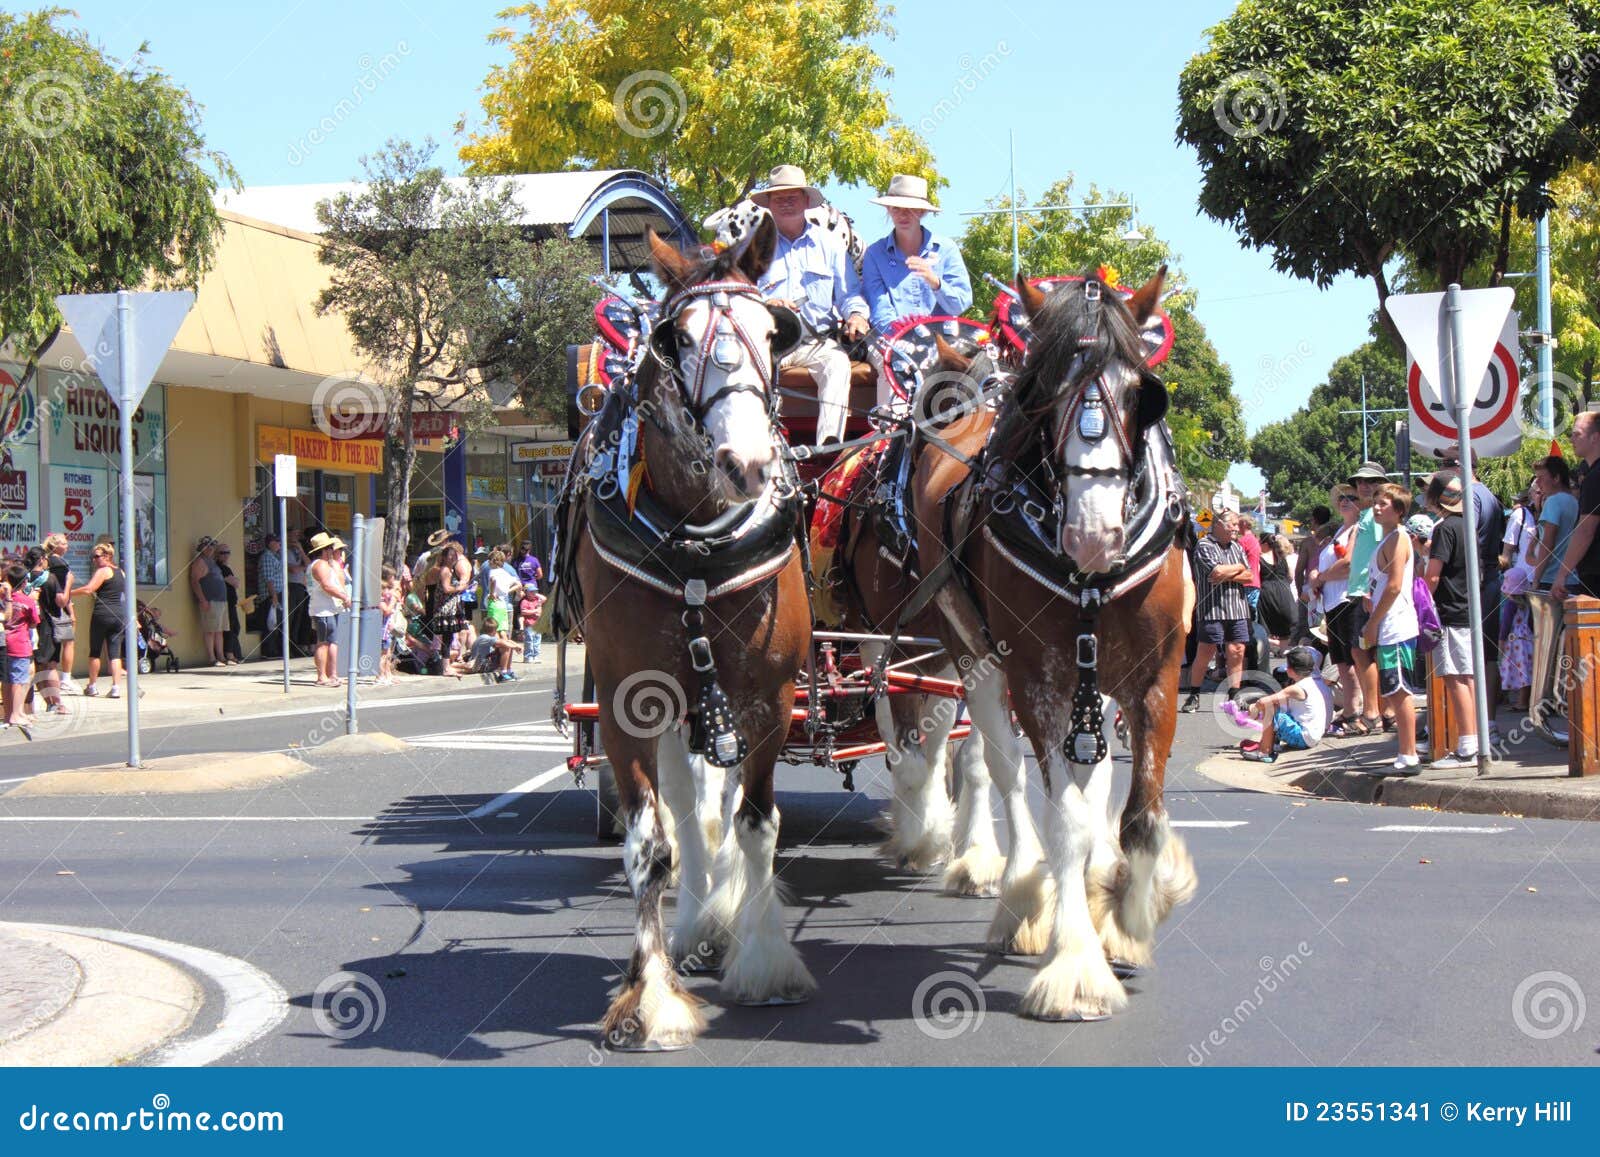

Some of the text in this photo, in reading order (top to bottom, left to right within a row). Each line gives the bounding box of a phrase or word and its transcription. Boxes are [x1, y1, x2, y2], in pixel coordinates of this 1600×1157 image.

[66, 385, 145, 423] RITCHS
[294, 436, 328, 460] BAKERY
[331, 440, 342, 462] BY
[344, 442, 361, 465] THE
[364, 445, 379, 467] BAY
[64, 473, 92, 485] RITCHIES
[64, 487, 92, 498] SENIORS
[63, 498, 94, 531] 5%
[0, 522, 15, 541] EAST
[64, 532, 95, 542] ISCOUNT
